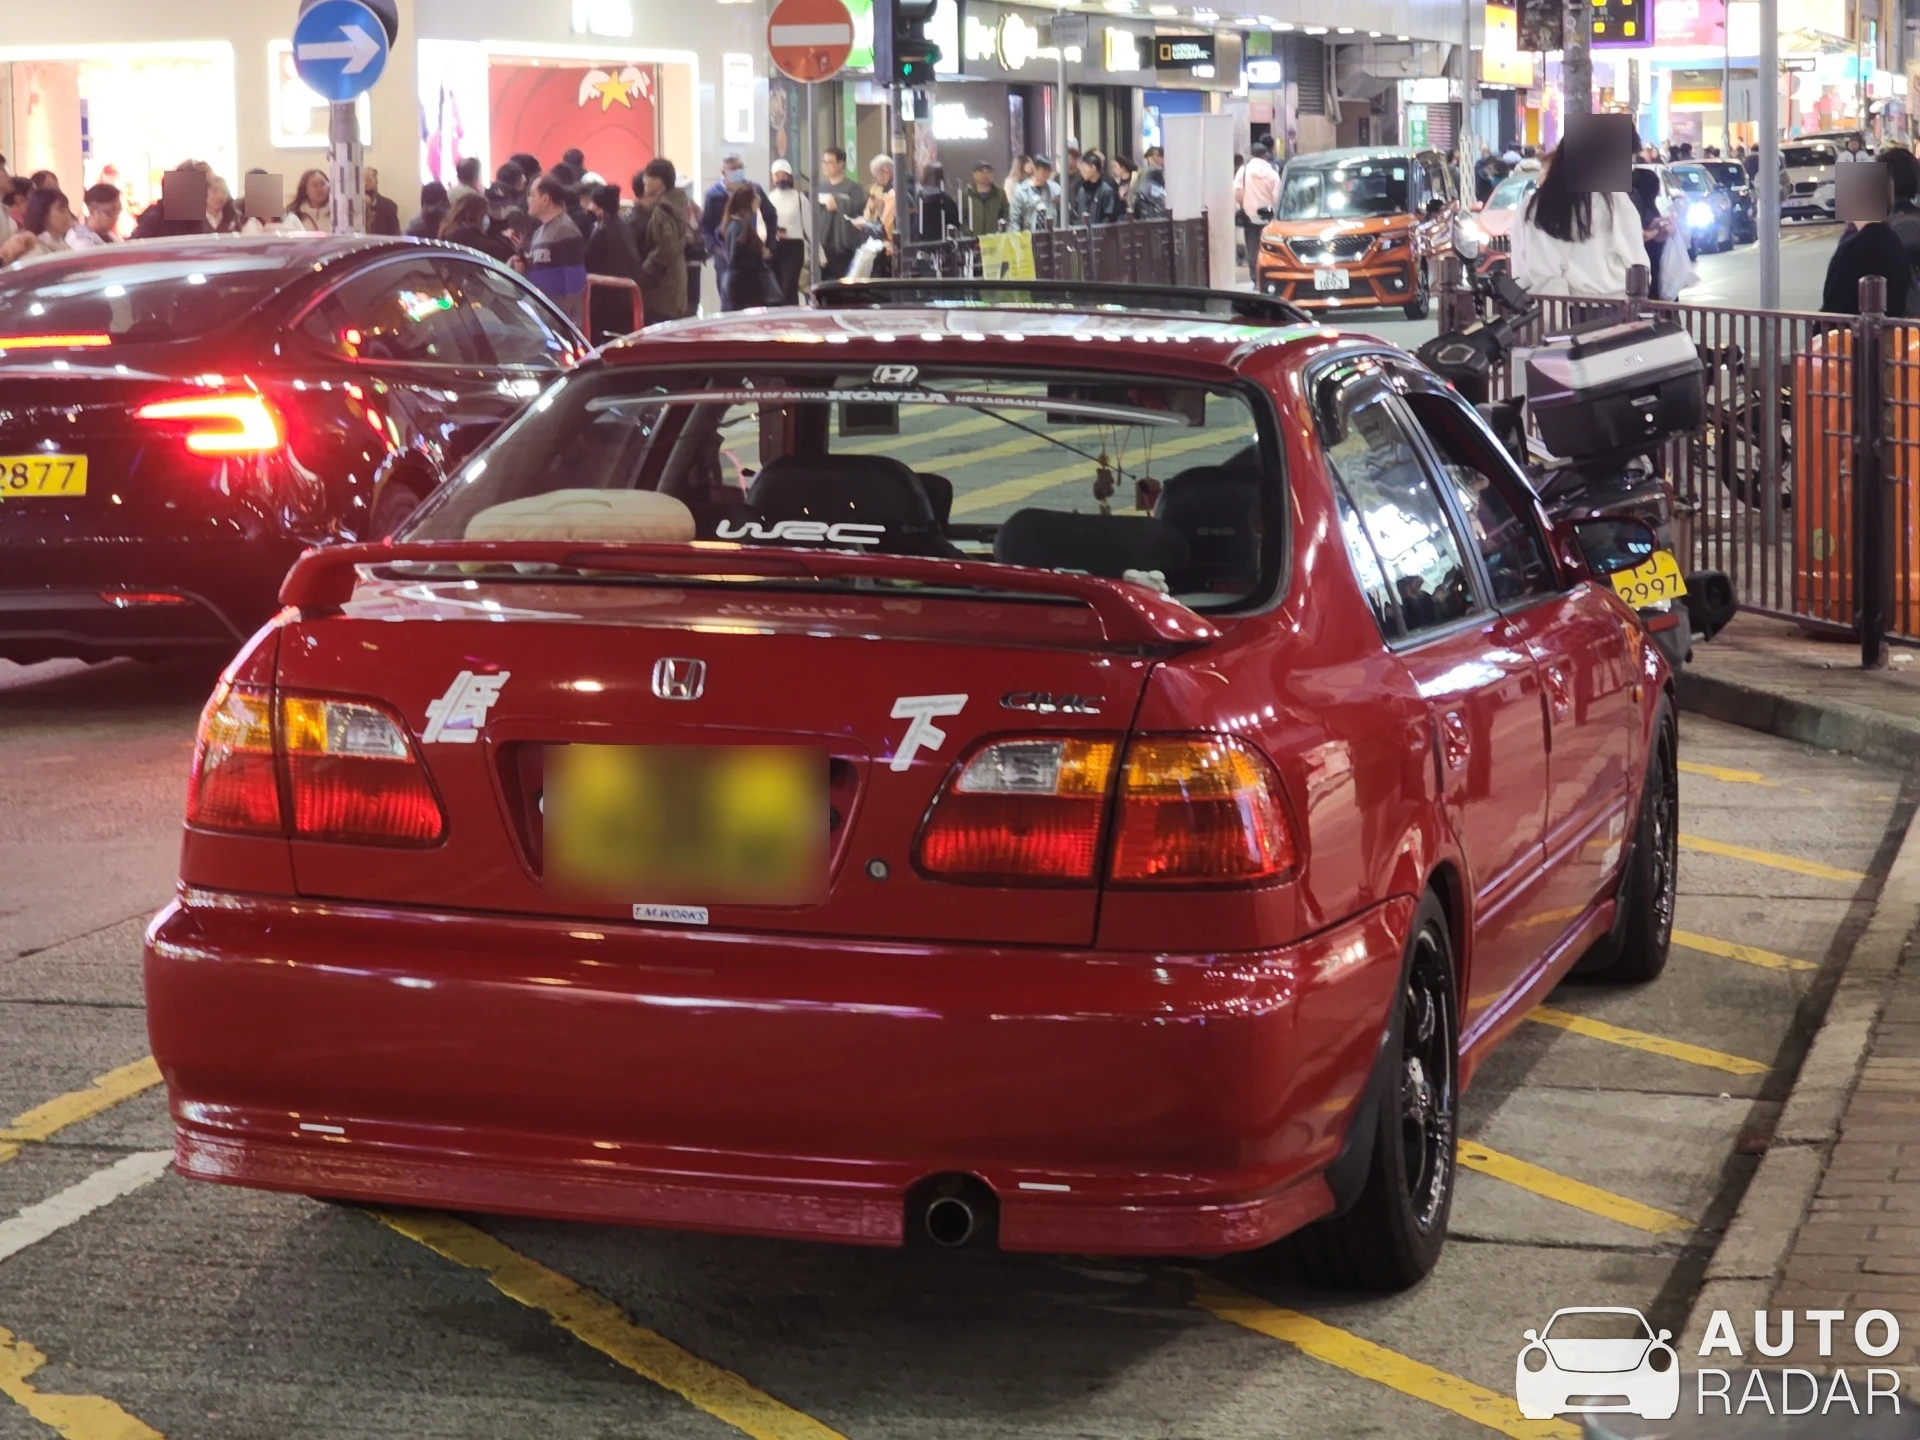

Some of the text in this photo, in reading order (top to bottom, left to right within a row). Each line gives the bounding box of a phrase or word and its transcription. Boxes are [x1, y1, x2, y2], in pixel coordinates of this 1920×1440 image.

[825, 391, 949, 403] HONDA
[716, 519, 886, 544] WRC
[1619, 573, 1678, 604] 2997
